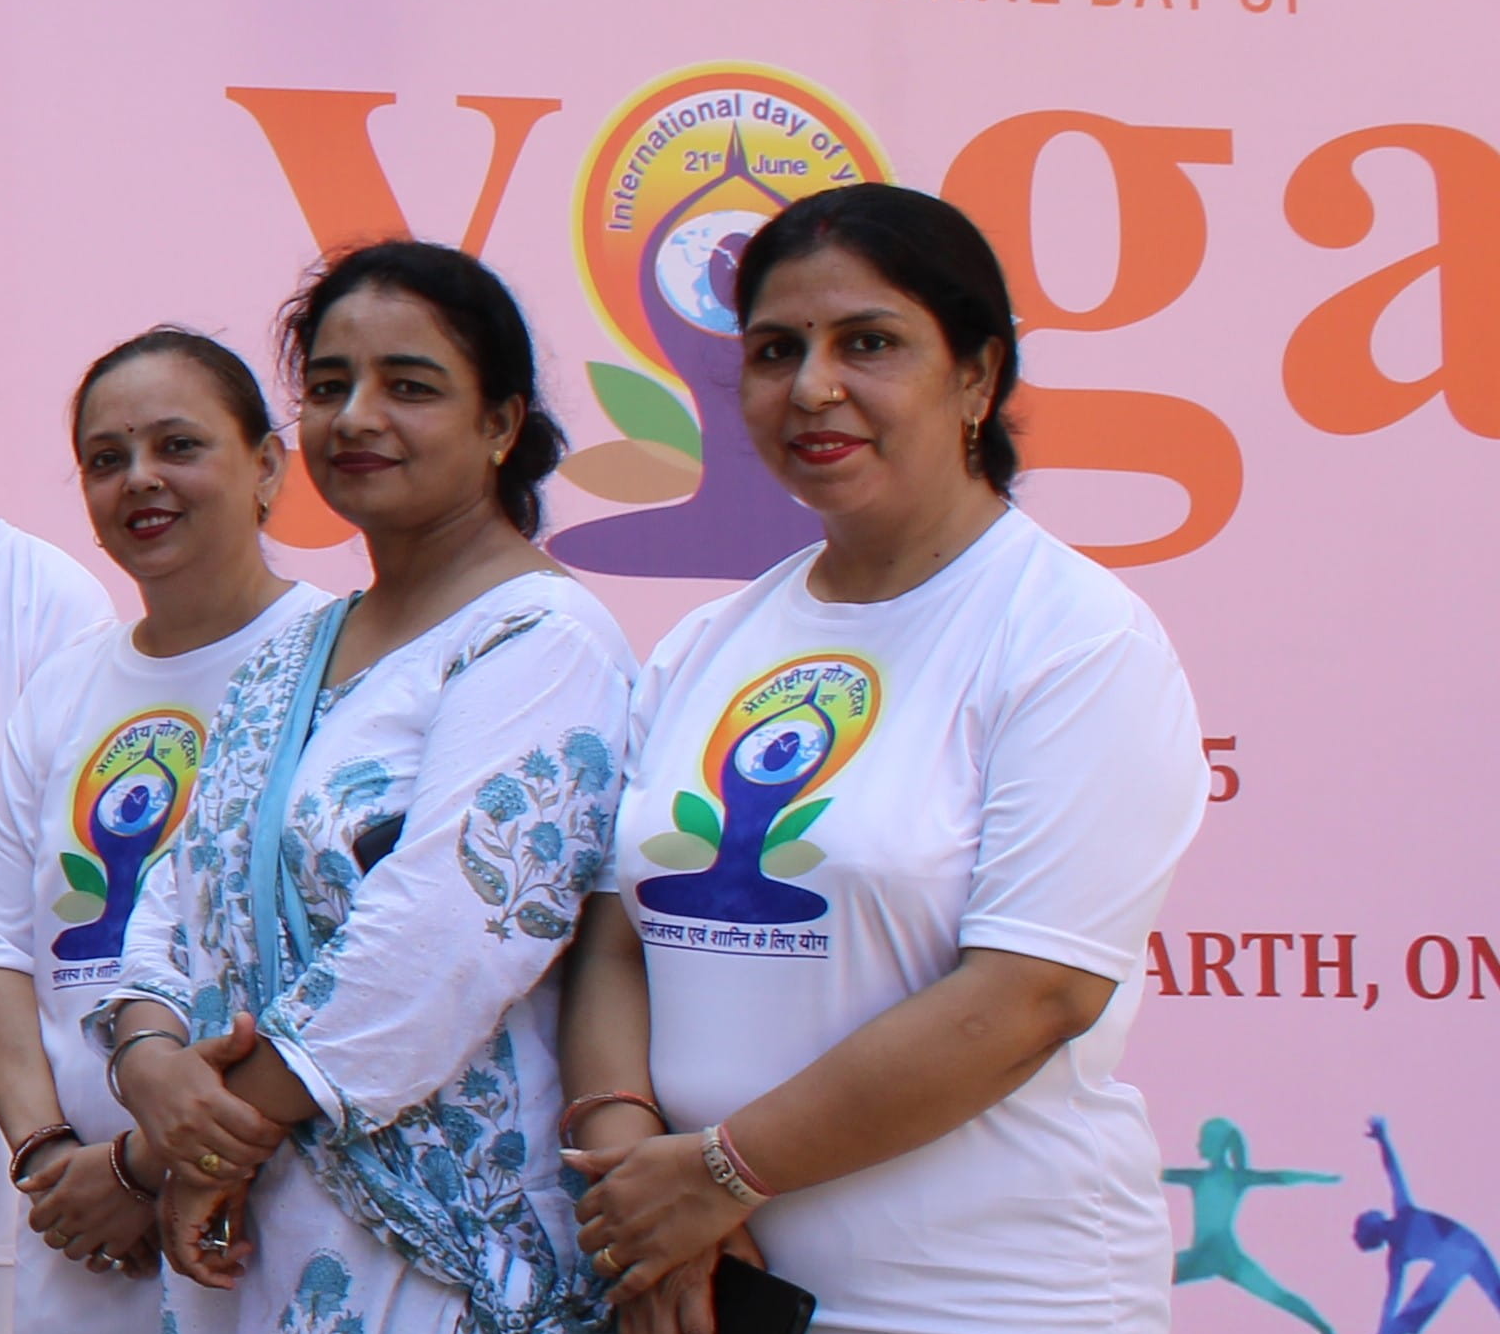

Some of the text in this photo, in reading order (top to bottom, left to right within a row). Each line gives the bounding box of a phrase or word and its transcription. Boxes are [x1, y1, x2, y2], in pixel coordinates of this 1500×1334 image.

[607, 93, 847, 232] International day of
[751, 154, 808, 175] June
[822, 664, 853, 687] योग
[155, 720, 182, 740] योग
[688, 924, 829, 952] एवं शान्ति के लिए योग
[1144, 932, 1500, 1009] ARTH, ON
